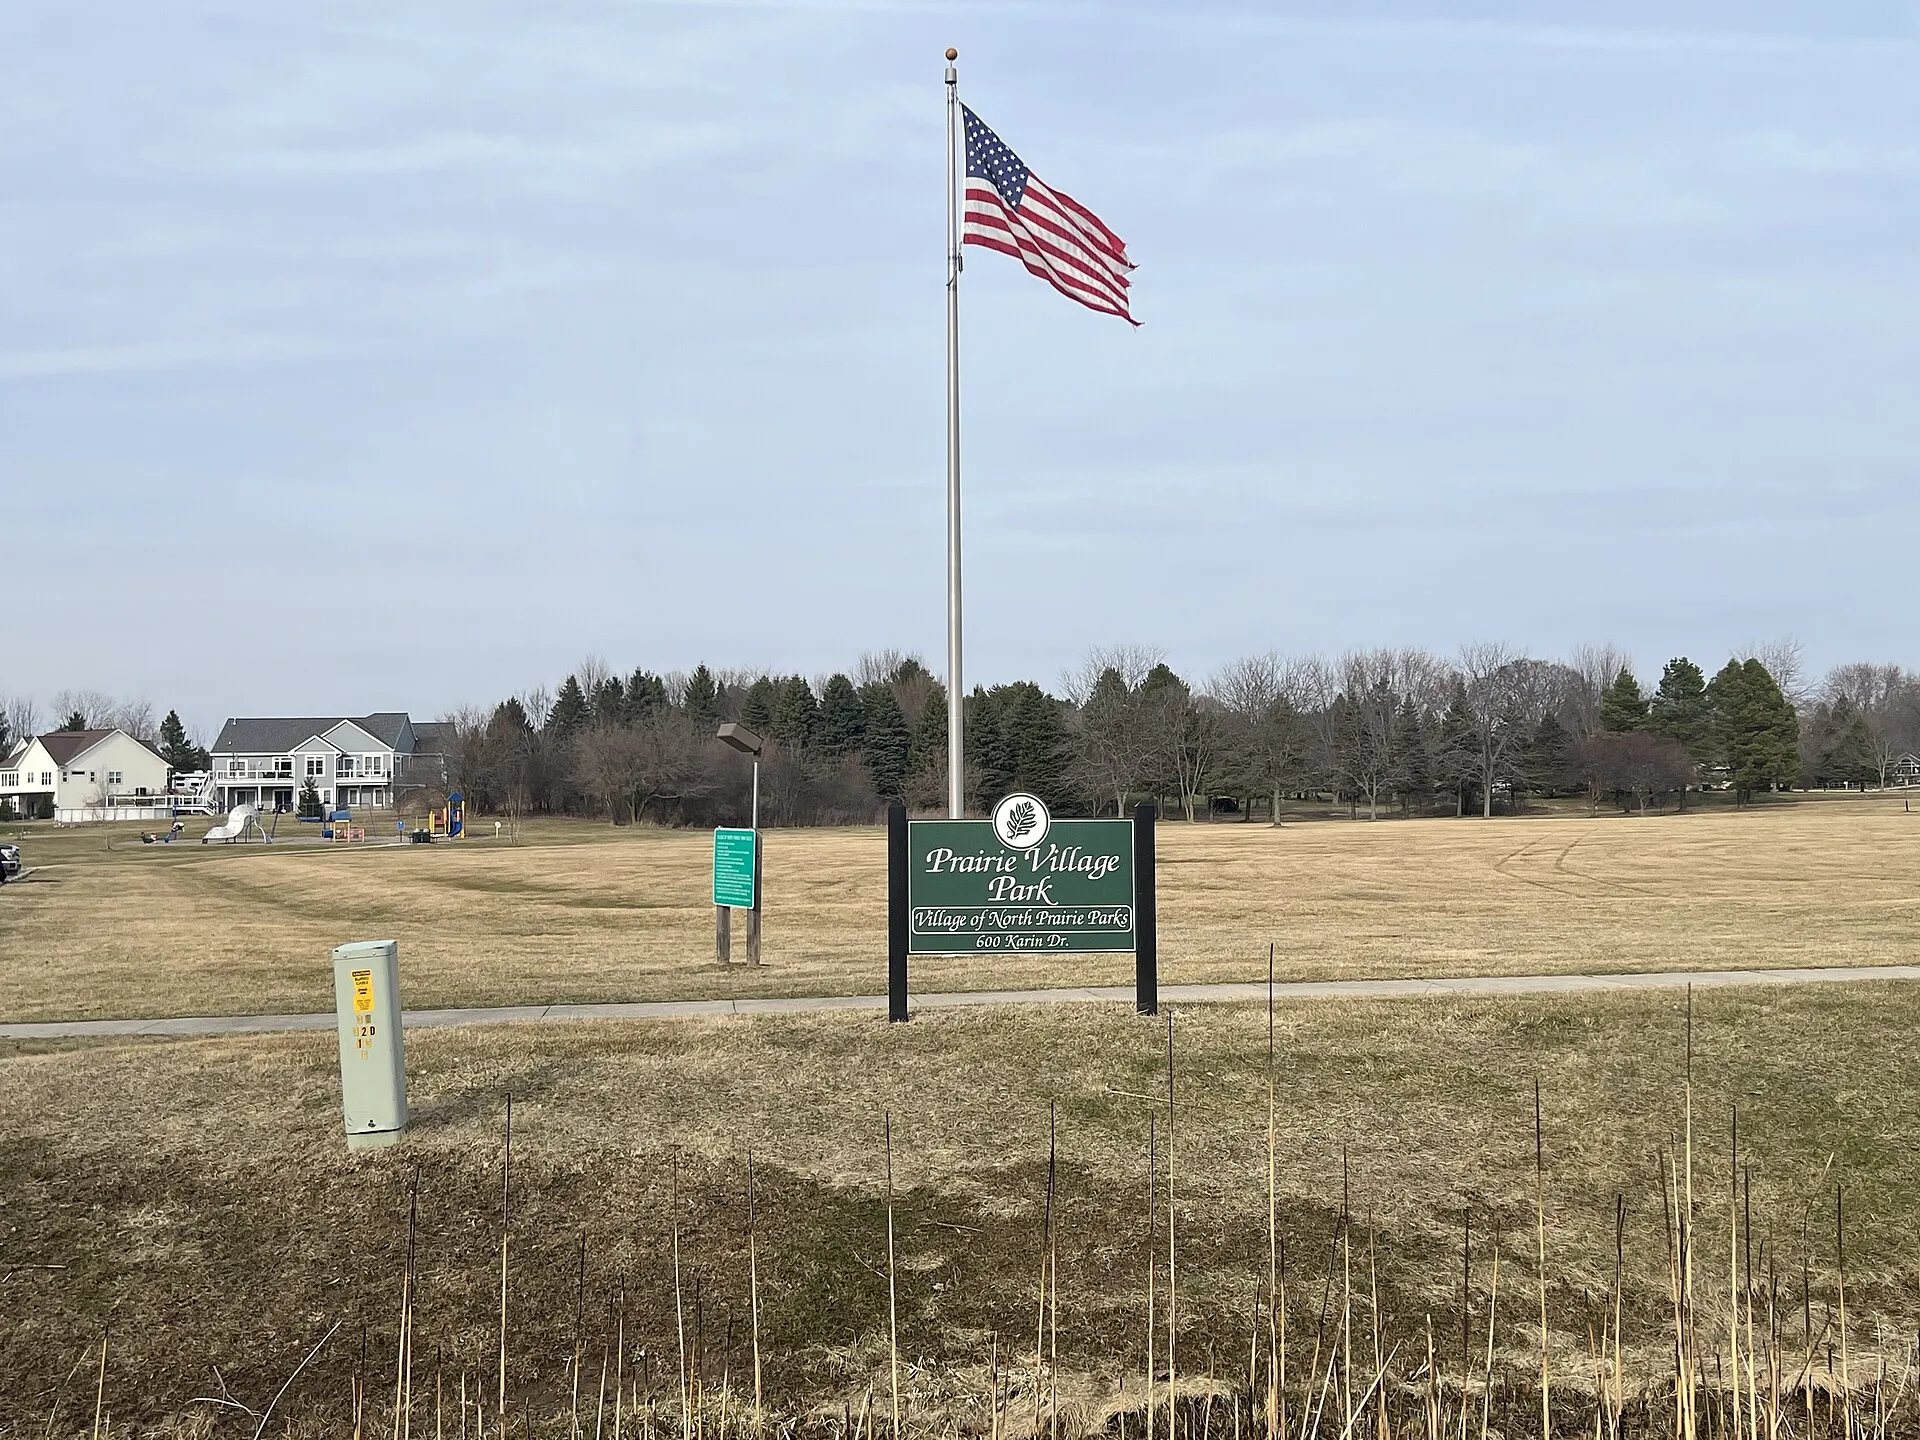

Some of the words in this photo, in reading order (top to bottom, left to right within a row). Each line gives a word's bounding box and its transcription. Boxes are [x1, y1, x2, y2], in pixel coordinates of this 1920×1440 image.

[925, 847, 1018, 874] Prairie
[1024, 843, 1120, 880] Village
[987, 875, 1059, 906] Park
[914, 908, 967, 932] Village
[970, 908, 987, 932] of
[988, 908, 1033, 929] North
[1035, 909, 1085, 927] Prairie
[1087, 908, 1129, 928] Parks
[975, 934, 1001, 948] 600
[1004, 934, 1043, 950] Karin
[1047, 934, 1069, 948] Dr.
